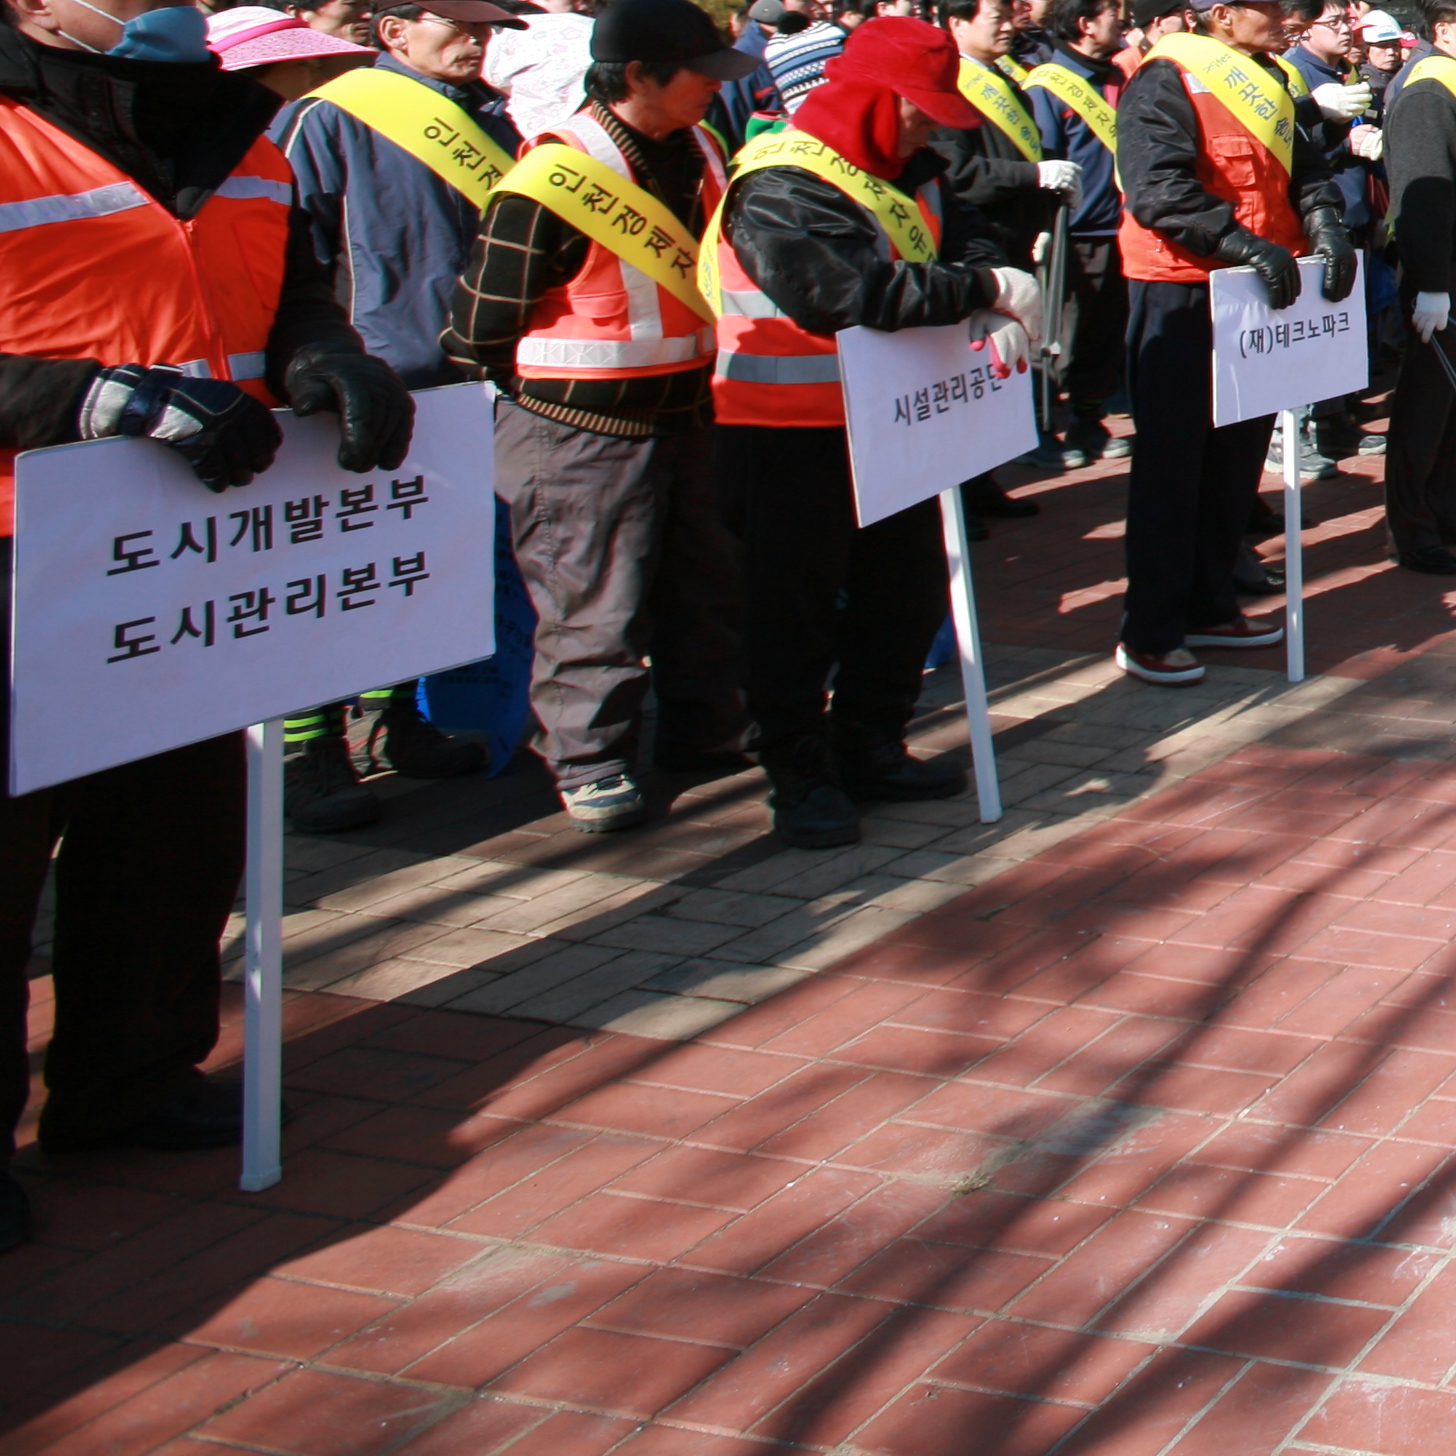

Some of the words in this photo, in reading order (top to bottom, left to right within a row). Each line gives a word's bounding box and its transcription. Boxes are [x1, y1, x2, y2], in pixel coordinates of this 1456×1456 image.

[1224, 65, 1278, 121] 깨끗한
[1239, 310, 1351, 359] (재)테크노파크
[893, 361, 1005, 427] 시설관리공단
[107, 474, 430, 576] 도시개발본부
[107, 550, 431, 664] 도시관리본부
